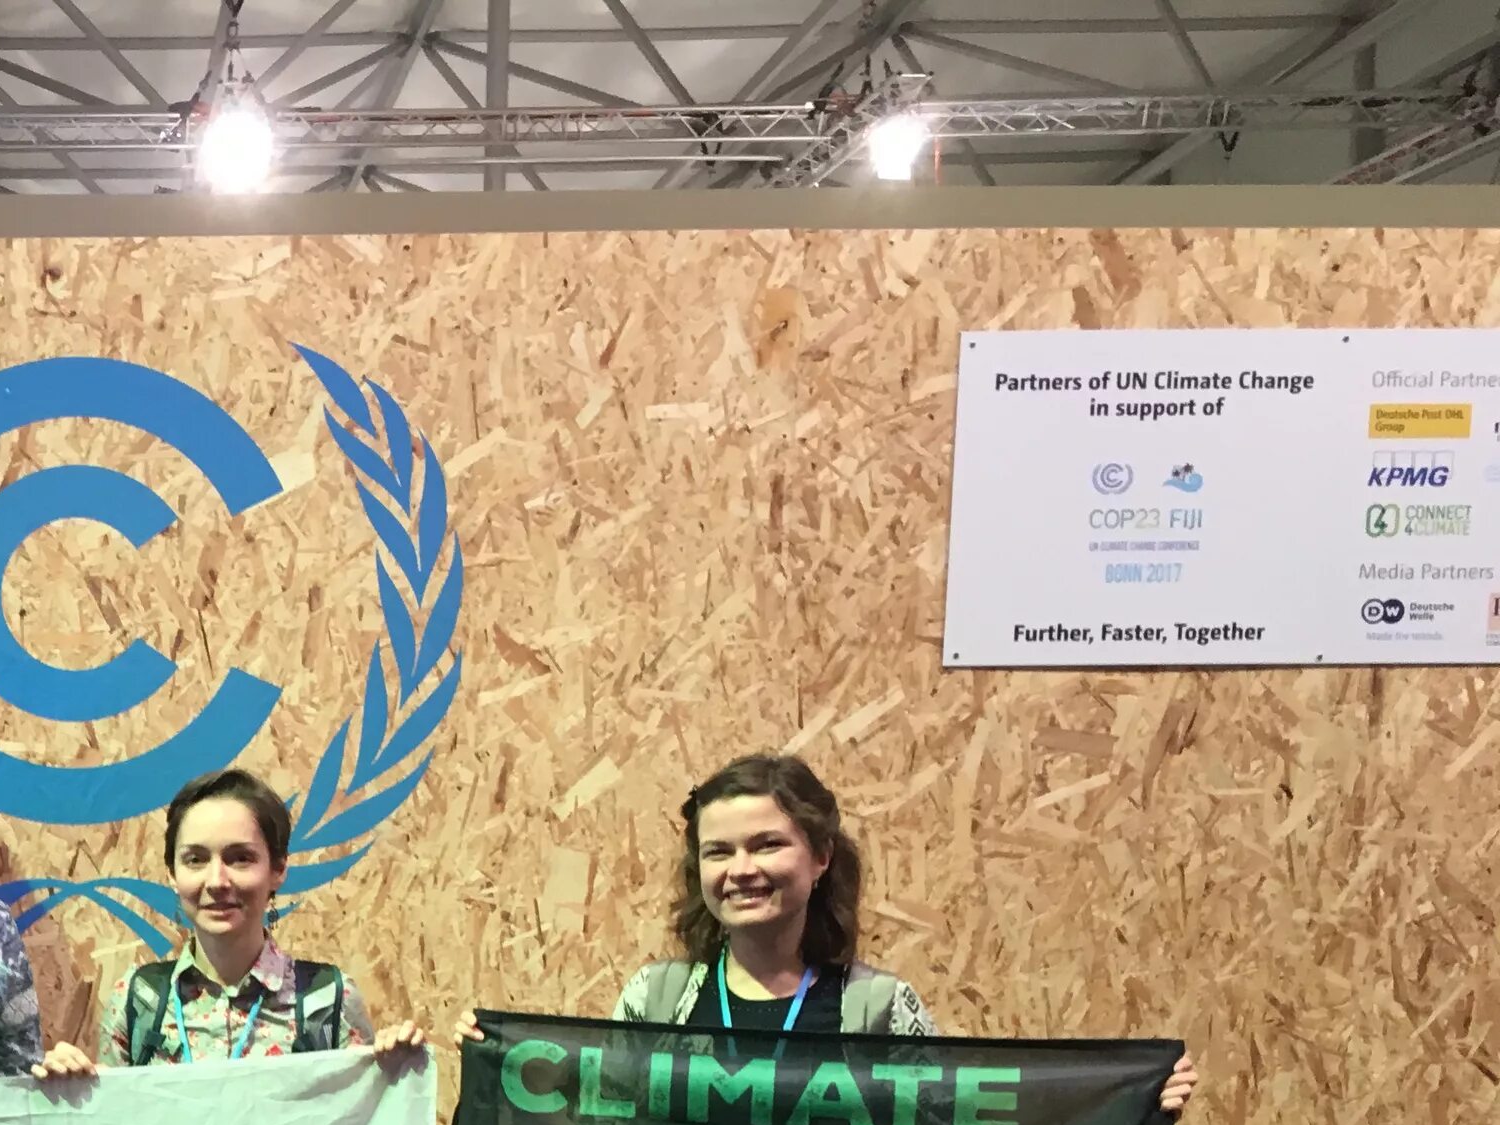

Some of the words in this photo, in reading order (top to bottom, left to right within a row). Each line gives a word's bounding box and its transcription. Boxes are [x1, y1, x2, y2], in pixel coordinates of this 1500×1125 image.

[995, 373, 1082, 391] Partners
[1088, 371, 1111, 390] of
[1116, 372, 1148, 390] UN
[1154, 371, 1232, 389] Climate
[1238, 371, 1315, 394] Change
[1372, 370, 1433, 388] Official
[1440, 370, 1500, 388] Partne
[1089, 398, 1109, 416] in
[1115, 399, 1196, 420] support
[1202, 397, 1226, 416] of
[1367, 466, 1450, 487] KPMG
[1089, 508, 1161, 530] COP23
[1169, 508, 1203, 531] FIJI
[1405, 504, 1472, 520] CONNECT
[1105, 563, 1143, 583] BONN
[1146, 562, 1183, 583] 2017
[1358, 563, 1414, 580] Media
[1421, 563, 1494, 580] Partners
[1409, 602, 1455, 612] Deutsche
[1013, 623, 1095, 645] Further,
[1100, 623, 1168, 645] Faster,
[1174, 621, 1266, 646] Together
